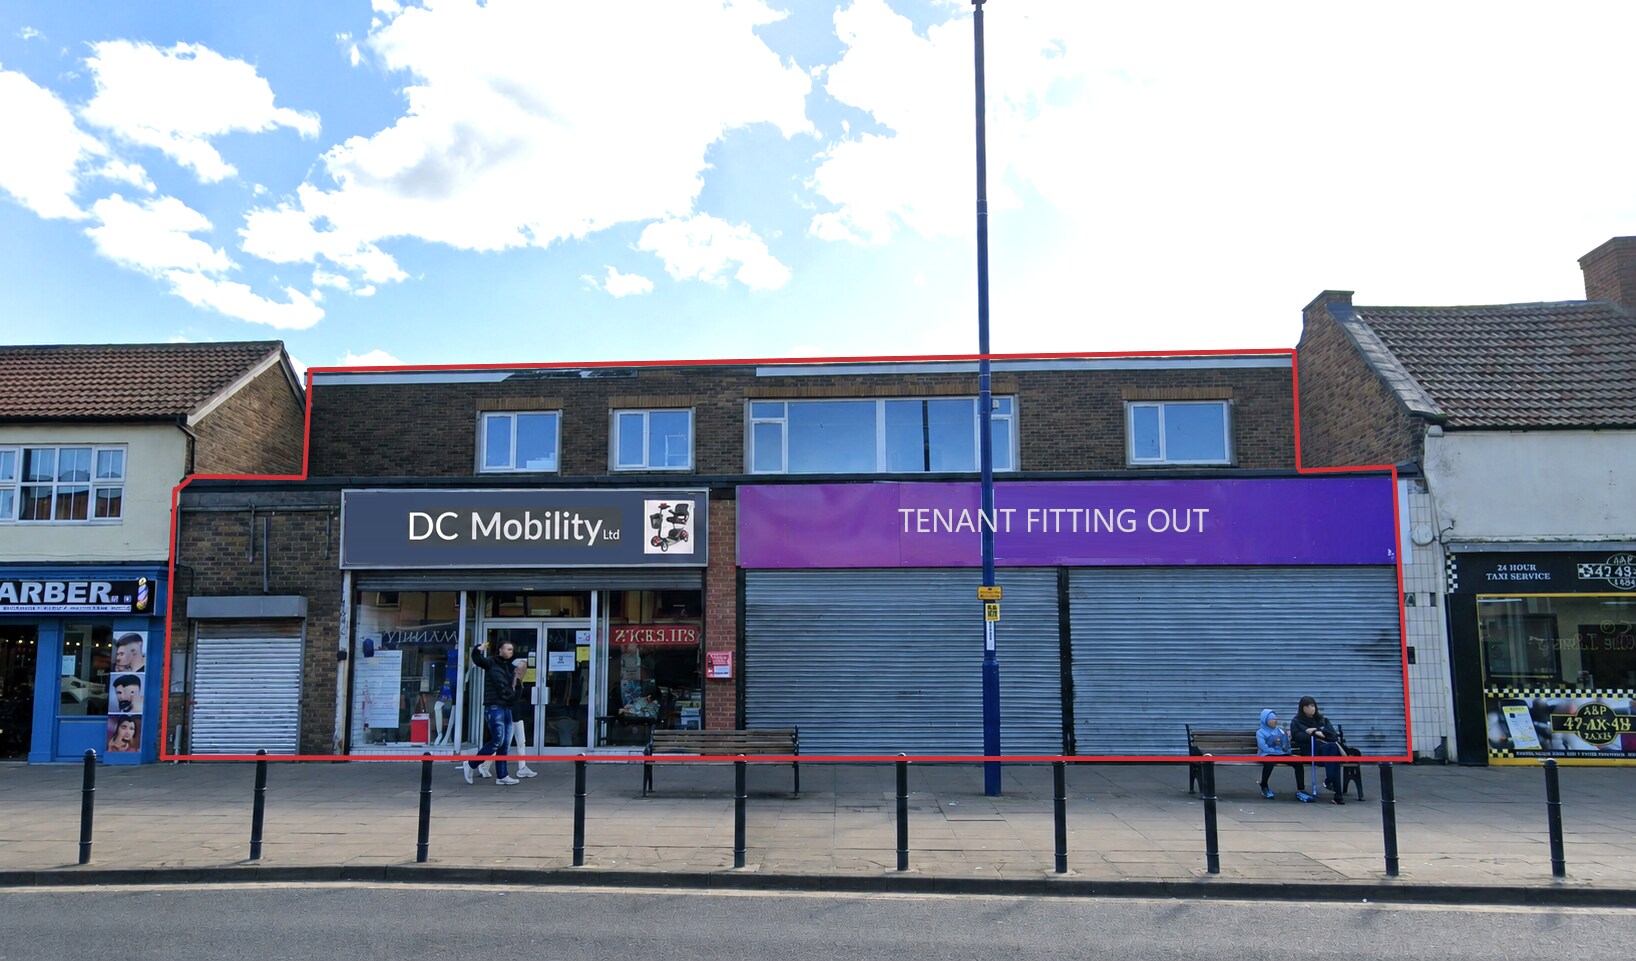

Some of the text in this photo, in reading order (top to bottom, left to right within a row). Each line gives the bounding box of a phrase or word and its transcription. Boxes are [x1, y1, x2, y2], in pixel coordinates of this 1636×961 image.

[409, 511, 620, 546] DC Mobility Ltd
